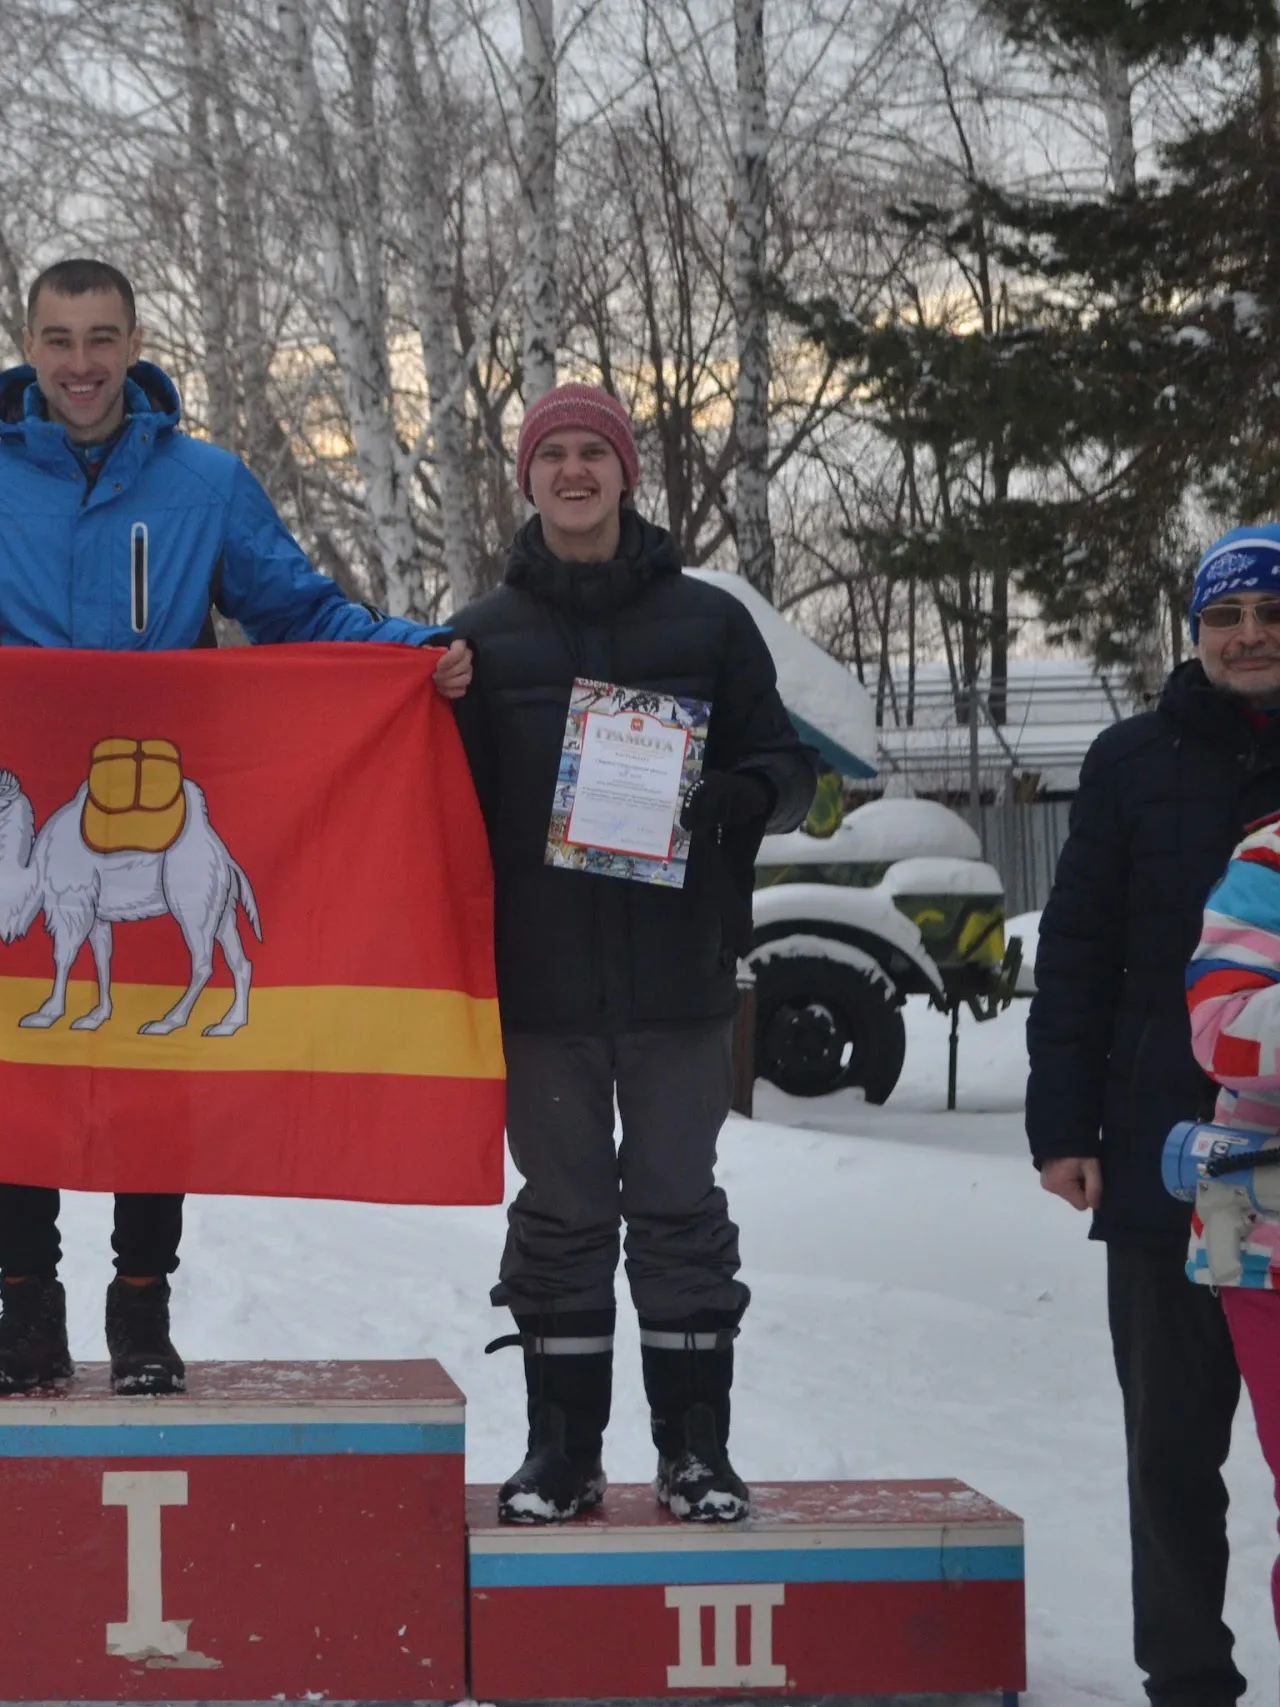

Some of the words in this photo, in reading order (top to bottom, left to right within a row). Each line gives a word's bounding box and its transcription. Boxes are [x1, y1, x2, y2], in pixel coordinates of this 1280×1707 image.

[595, 726, 674, 754] ГРАМОТА
[102, 1470, 189, 1656] I
[664, 1583, 786, 1688] III
